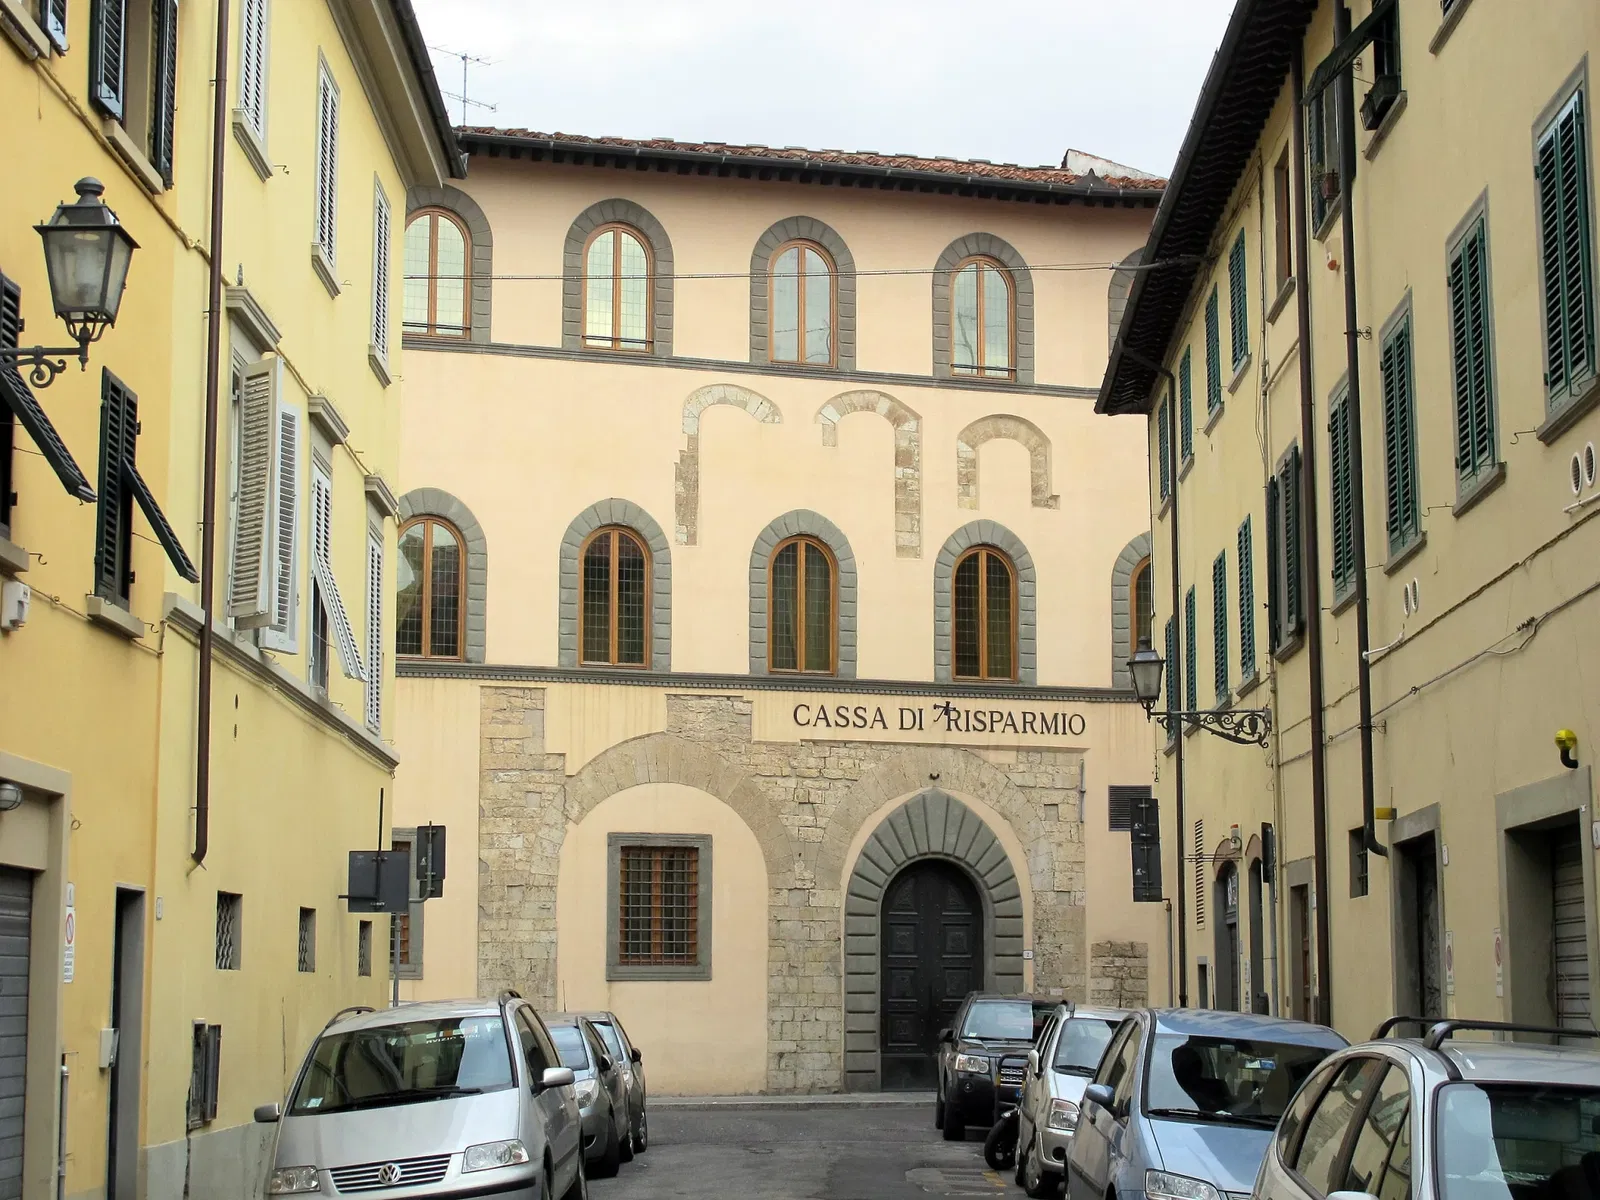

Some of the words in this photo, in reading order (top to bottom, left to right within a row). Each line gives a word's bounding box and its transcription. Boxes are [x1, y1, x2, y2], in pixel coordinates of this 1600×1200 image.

[793, 704, 888, 730] CASSA
[899, 708, 924, 731] DI
[945, 709, 1086, 735] RISPARMIO
